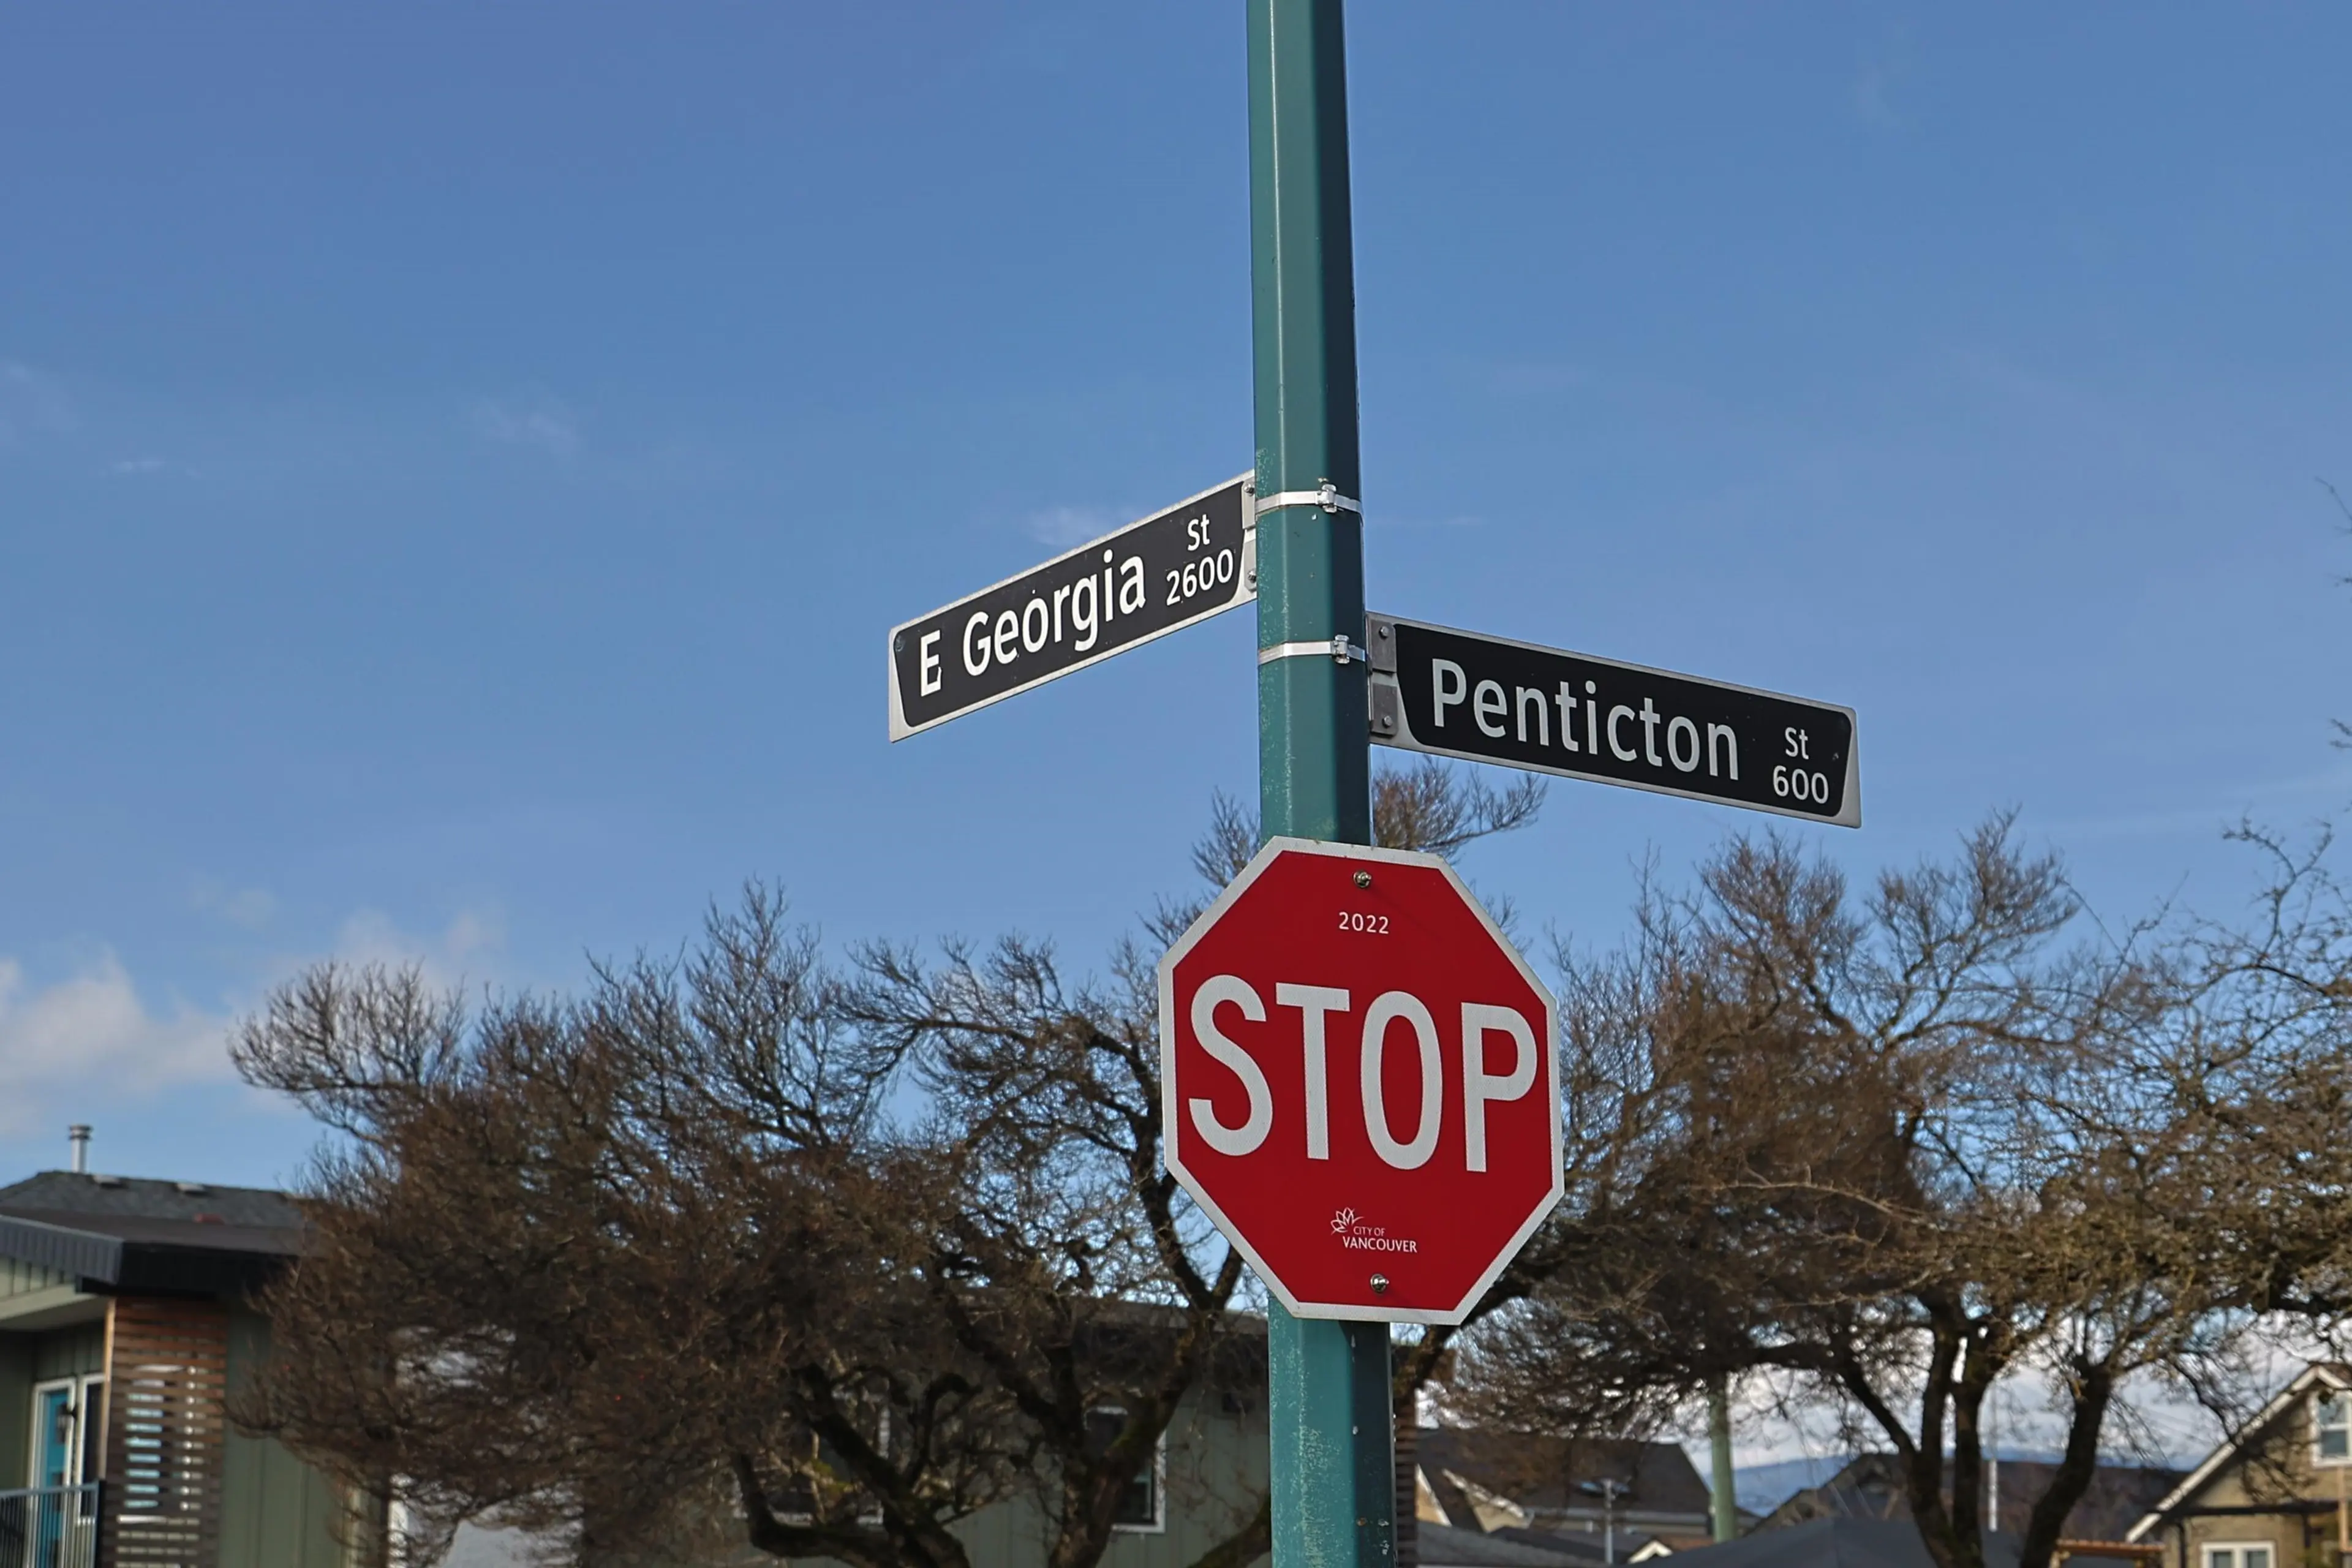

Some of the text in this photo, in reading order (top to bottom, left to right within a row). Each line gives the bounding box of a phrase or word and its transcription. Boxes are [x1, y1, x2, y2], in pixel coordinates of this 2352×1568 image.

[1187, 514, 1210, 551] St
[1166, 548, 1234, 606] 2600
[920, 549, 1146, 697] E Georgia
[1432, 658, 1739, 781] Penticton
[1784, 726, 1809, 760] St
[1773, 765, 1829, 805] 600
[1338, 911, 1389, 935] 2022
[1188, 974, 1539, 1173] STOP
[1343, 1236, 1417, 1253] VANCOUVER
[1353, 1226, 1385, 1237] CITY OF
